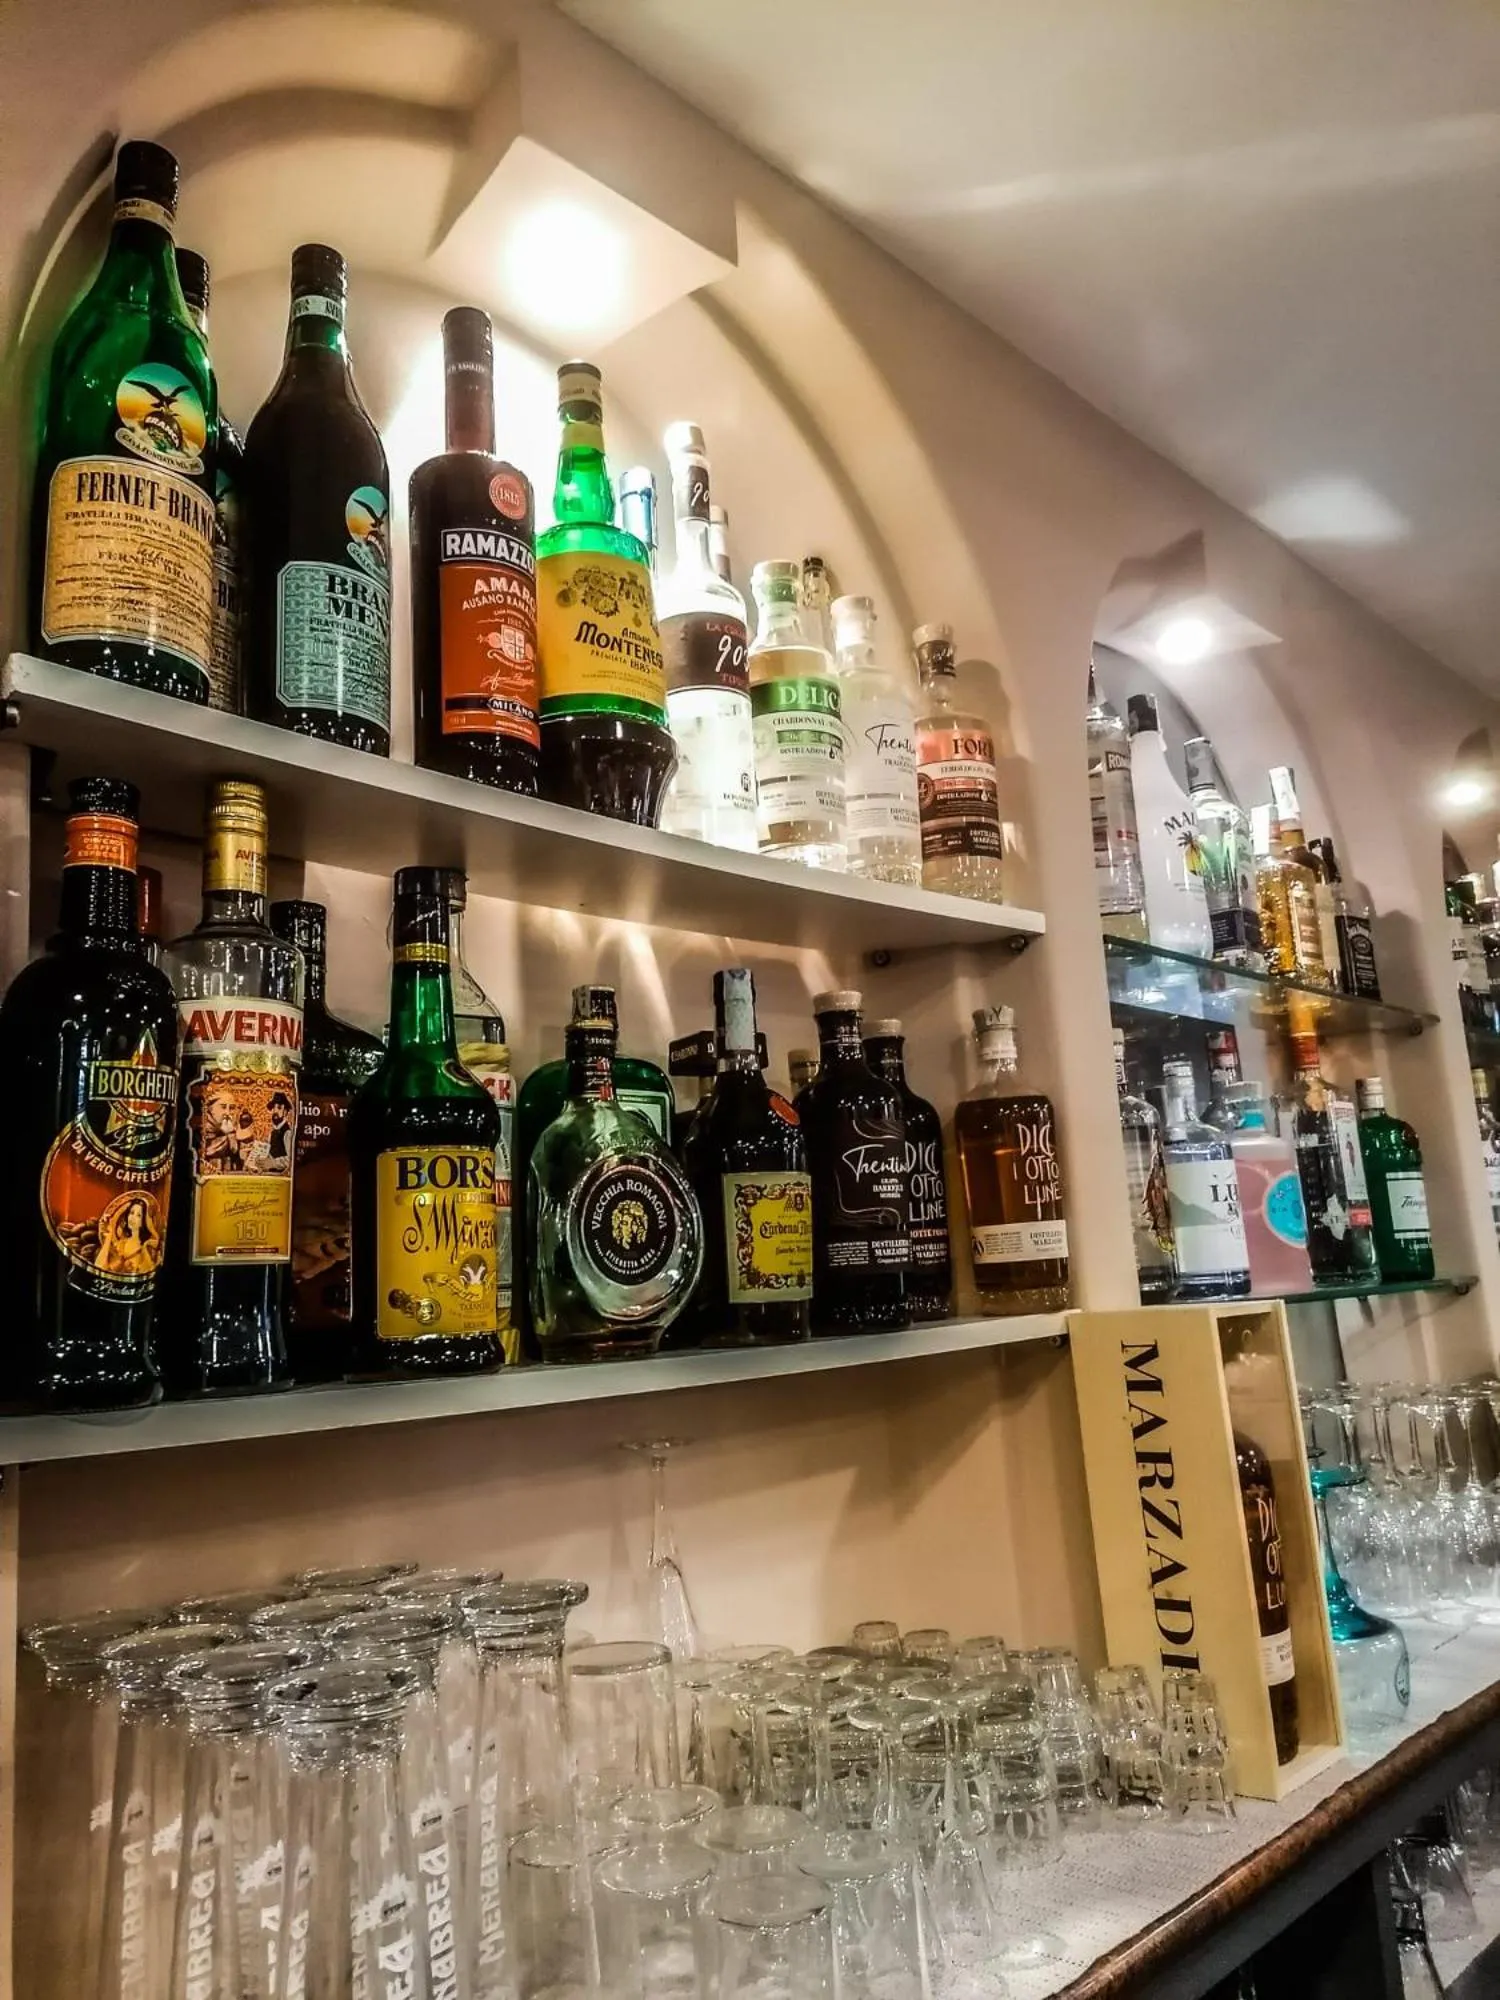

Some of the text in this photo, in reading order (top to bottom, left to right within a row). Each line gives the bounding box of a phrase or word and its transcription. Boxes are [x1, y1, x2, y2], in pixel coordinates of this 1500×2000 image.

[493, 701, 534, 719] MILANO
[72, 1140, 83, 1154] DI
[84, 1151, 114, 1175] VERO
[1026, 1156, 1059, 1182] OTTO
[911, 1173, 944, 1200] OTTO
[1024, 1182, 1063, 1205] LUNE
[591, 1179, 668, 1231] VECCHIA ROMAGNA
